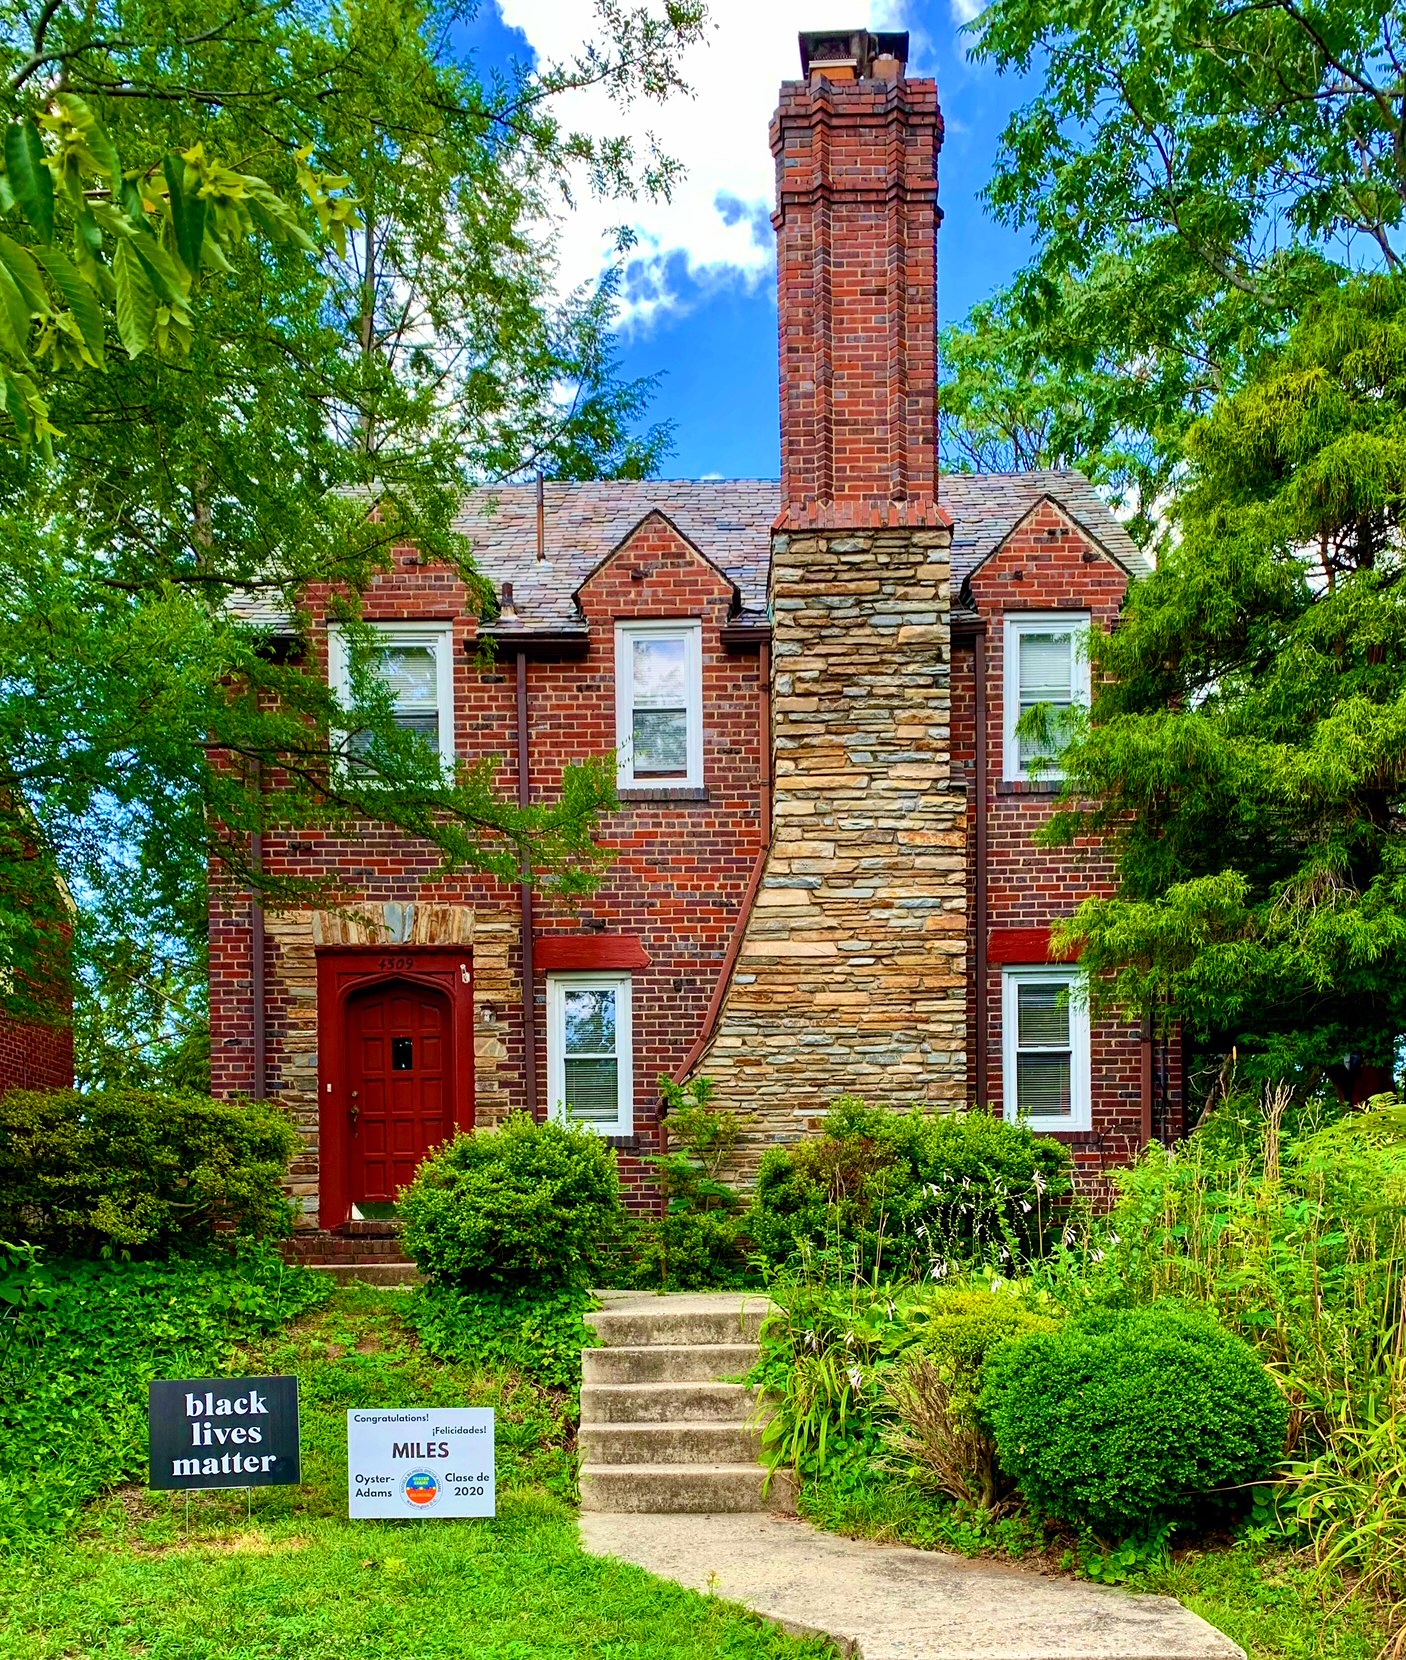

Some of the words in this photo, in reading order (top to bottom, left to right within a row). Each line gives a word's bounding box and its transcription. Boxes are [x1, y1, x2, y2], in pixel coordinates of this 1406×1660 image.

[185, 1390, 269, 1416] black
[354, 1414, 429, 1424] Congratulations!
[191, 1422, 262, 1446] lives
[432, 1426, 487, 1436] ¡Felicidades!
[392, 1442, 449, 1459] MILES
[172, 1452, 277, 1476] matter
[355, 1474, 395, 1486] Oyster-
[445, 1473, 476, 1482] Clase
[480, 1472, 490, 1482] de
[355, 1488, 393, 1498] Adams
[454, 1487, 484, 1496] 2020
